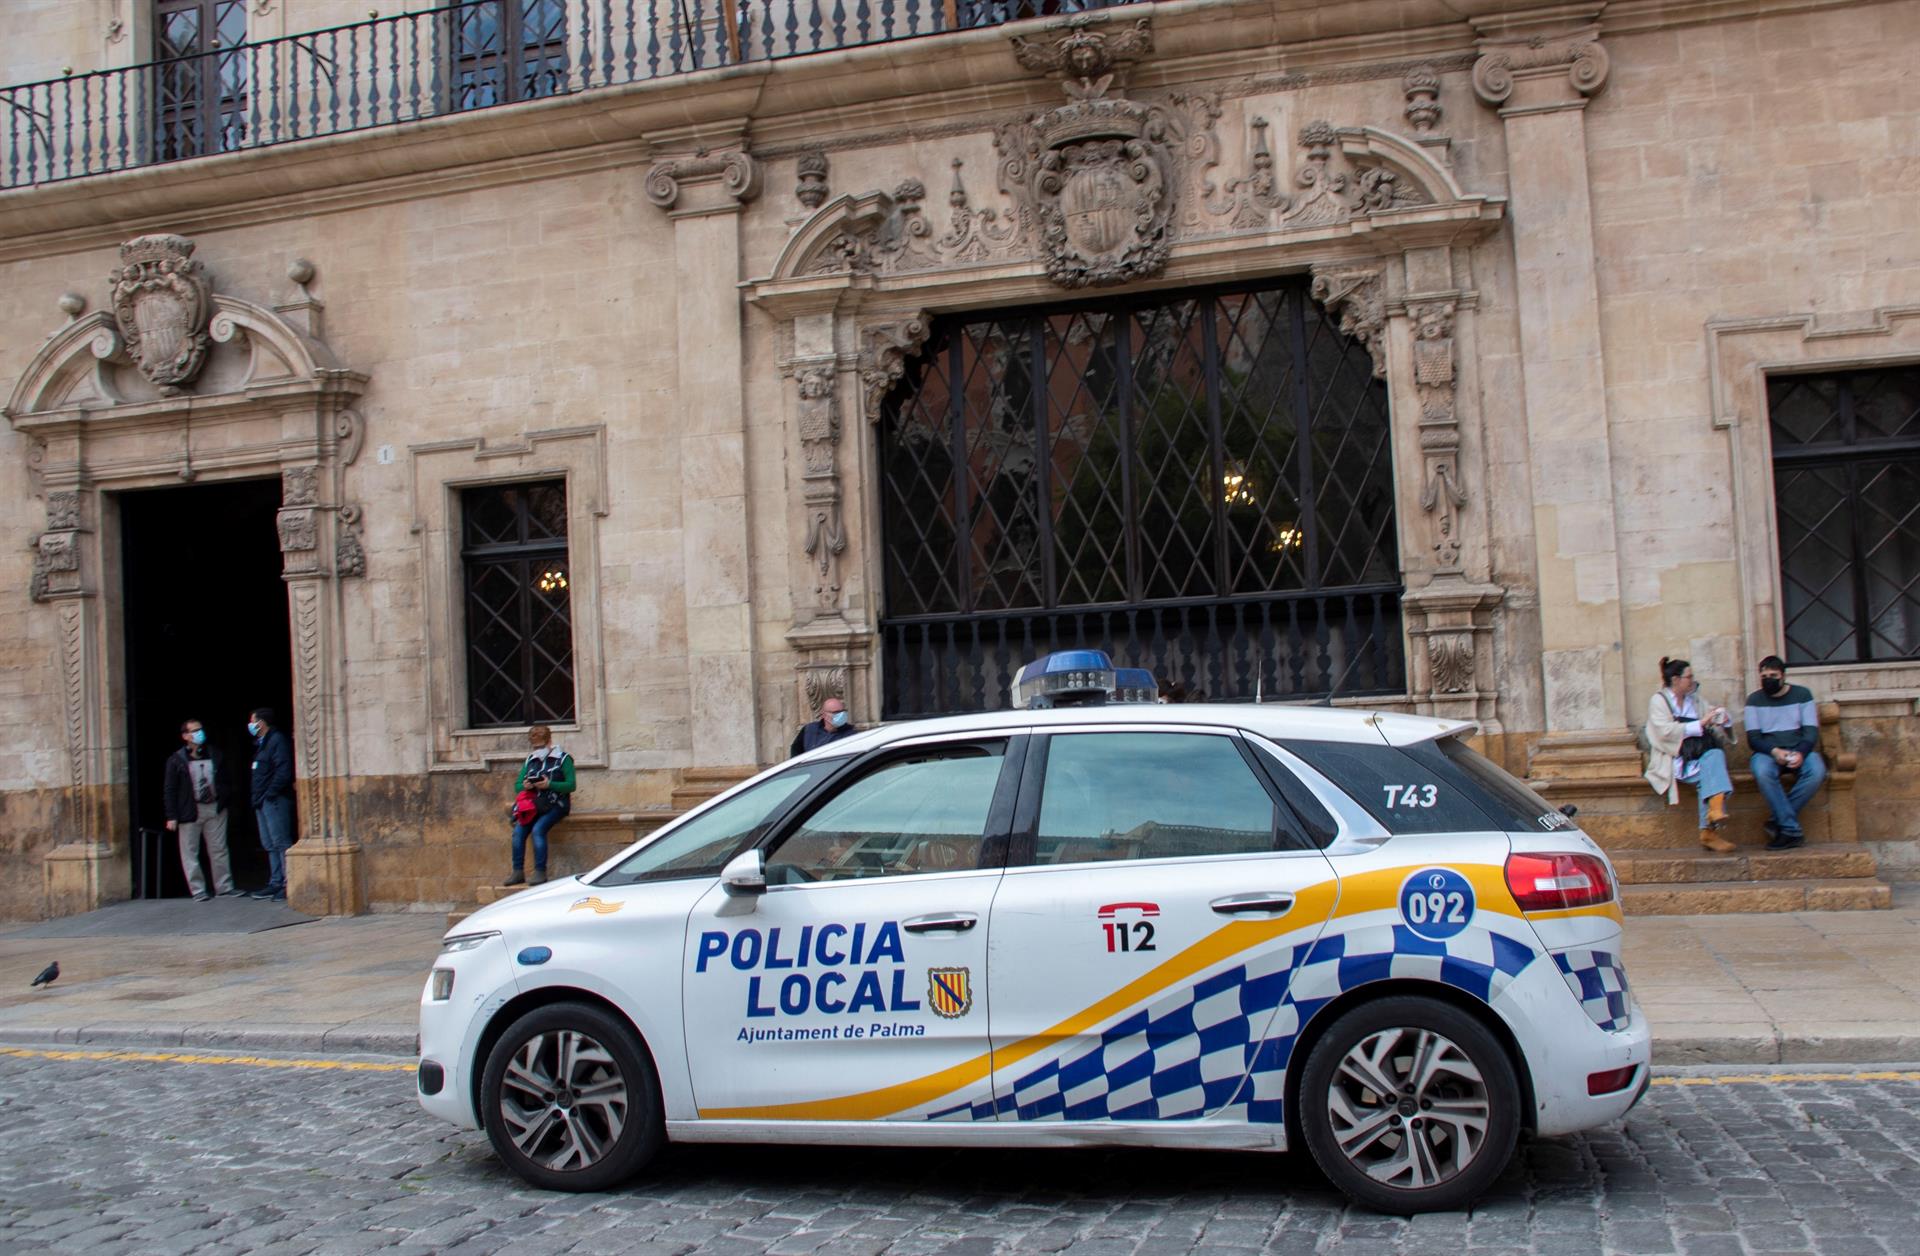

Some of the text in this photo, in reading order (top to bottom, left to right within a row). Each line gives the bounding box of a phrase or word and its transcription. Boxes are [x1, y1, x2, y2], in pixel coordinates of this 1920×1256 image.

[1383, 784, 1438, 809] T43
[1408, 892, 1466, 924] 092
[696, 921, 905, 972] POLICIA
[1102, 920, 1156, 952] 112
[747, 969, 921, 1018] LOCAL
[737, 1022, 925, 1044] Ajuntament de Palma
